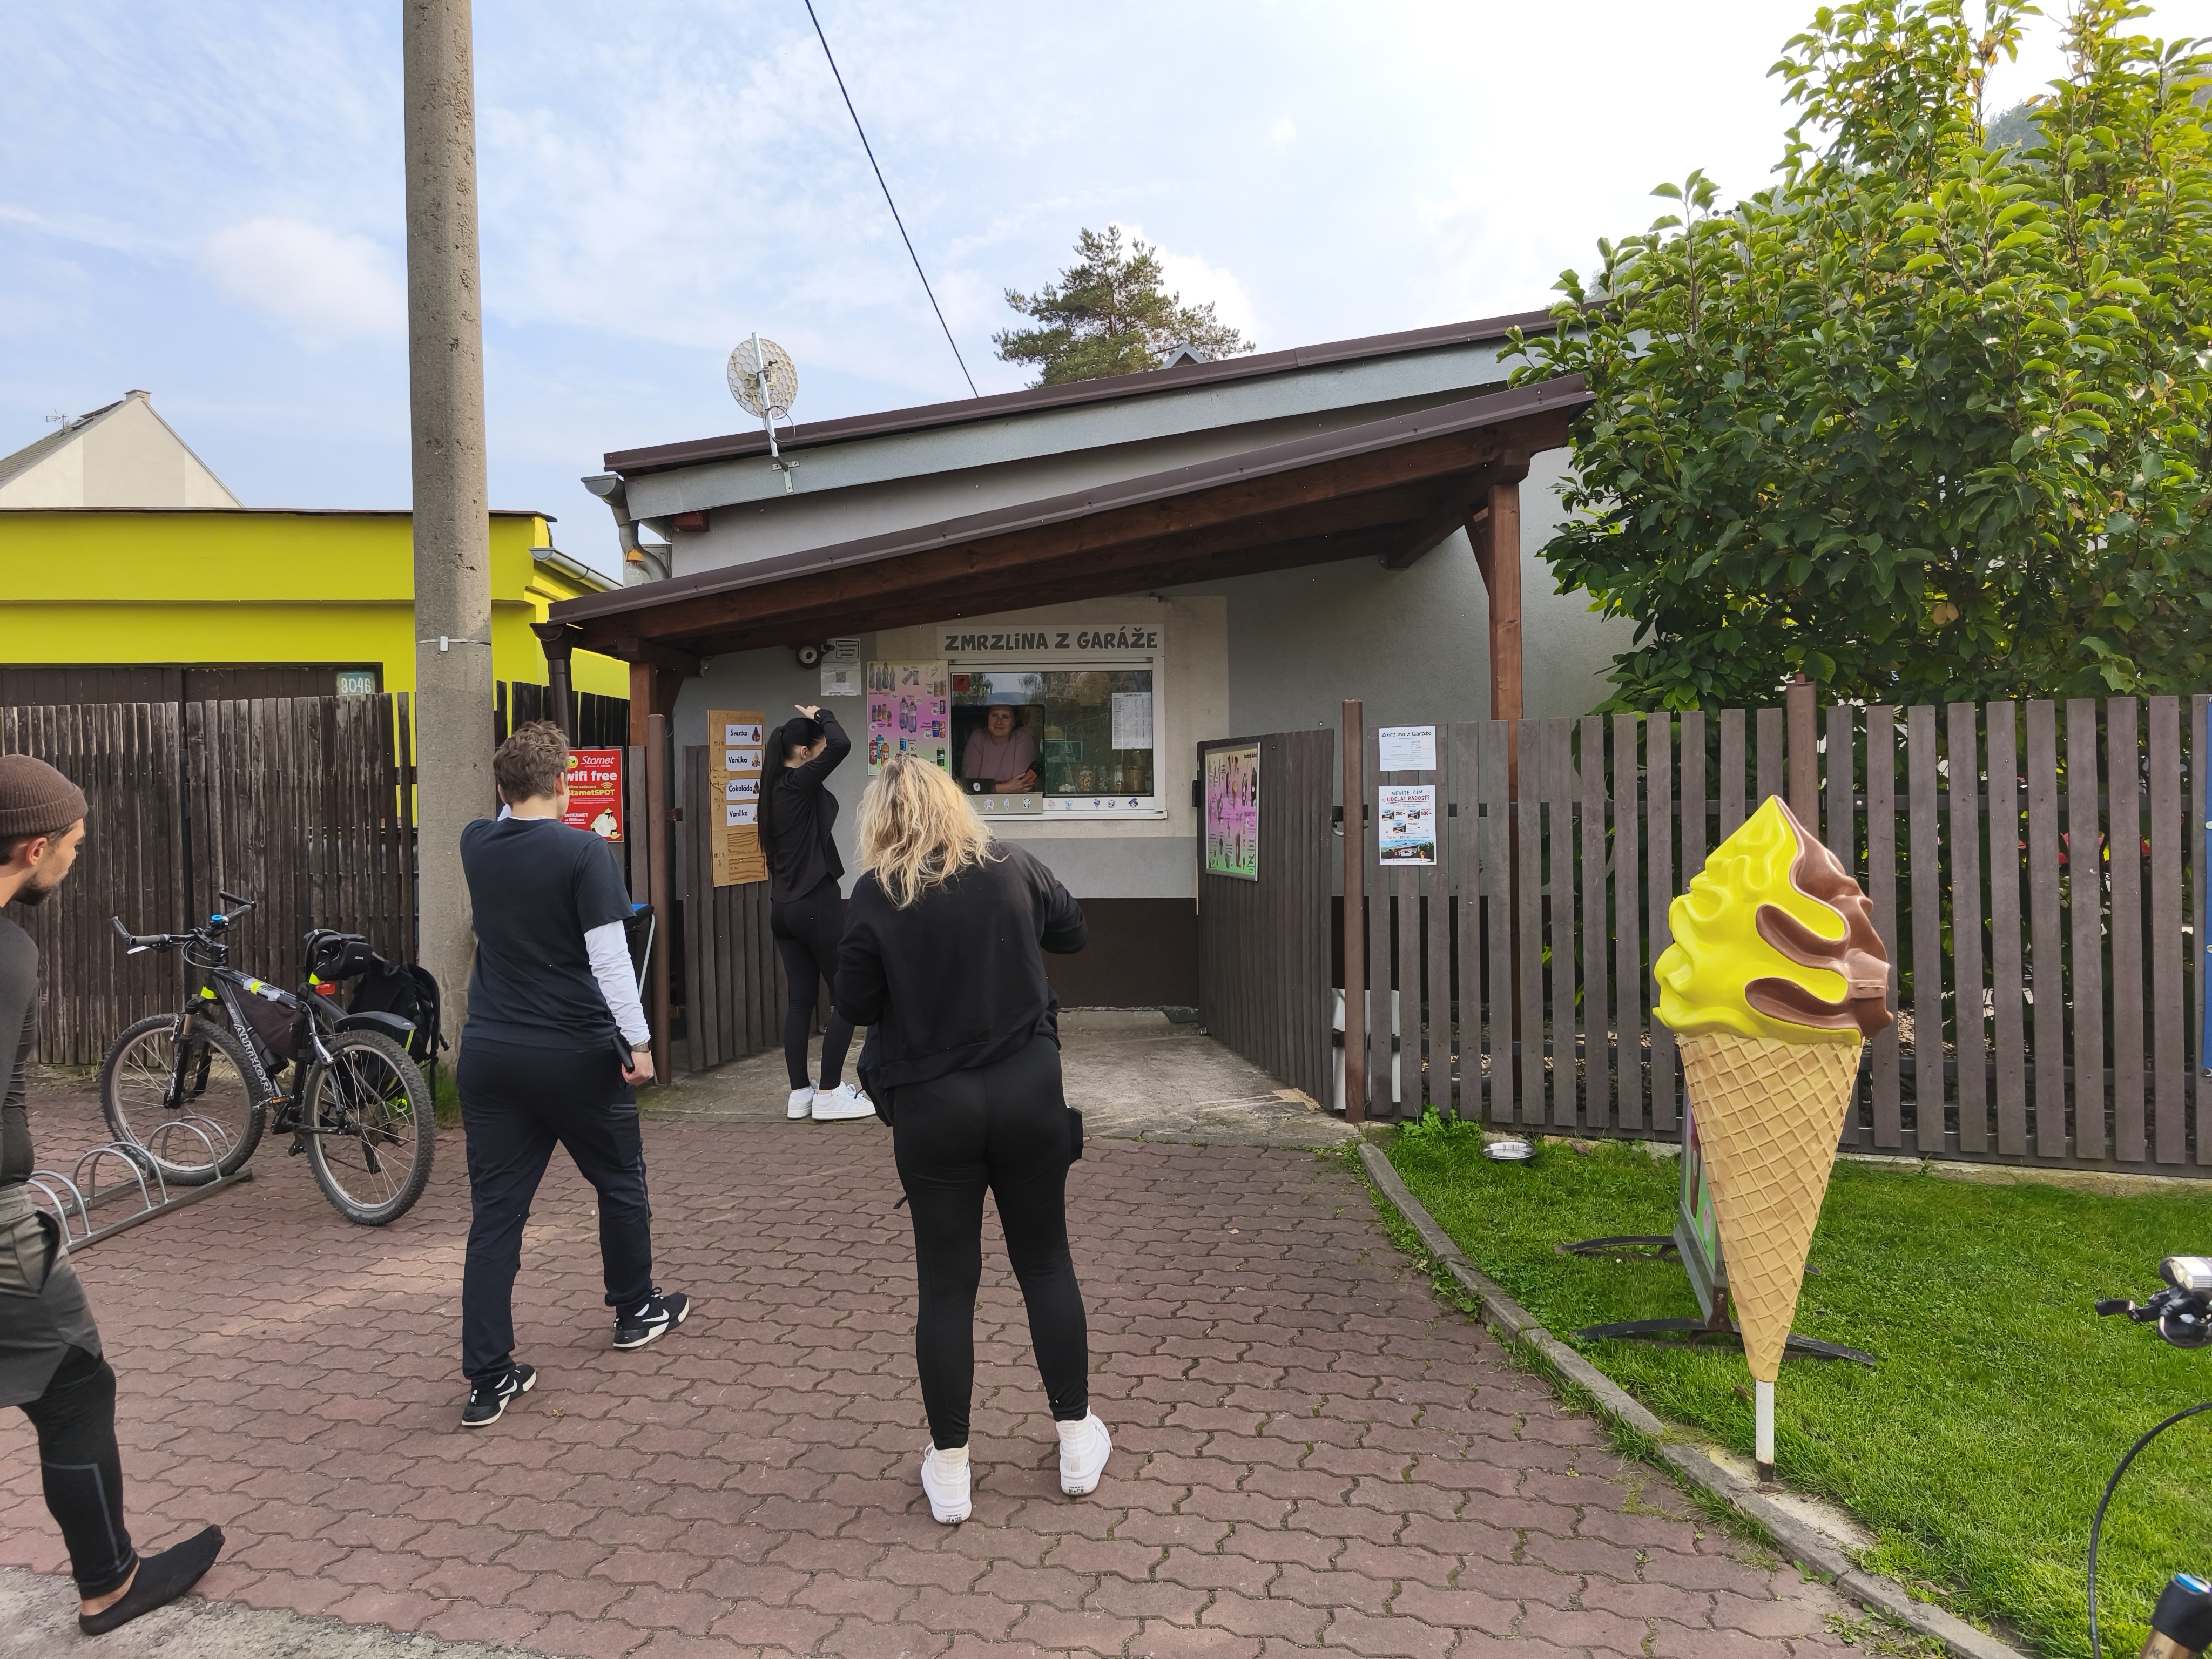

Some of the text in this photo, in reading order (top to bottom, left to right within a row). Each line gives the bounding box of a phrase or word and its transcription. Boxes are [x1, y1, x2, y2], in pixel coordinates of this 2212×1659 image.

[1055, 632, 1070, 649] Z
[1077, 625, 1157, 649] GARÁŽE
[730, 728, 747, 736] Švestka
[591, 770, 617, 781] free
[729, 783, 753, 792] Čokoláda
[713, 795, 724, 803] mix
[233, 1023, 272, 1092] AUTHOR
